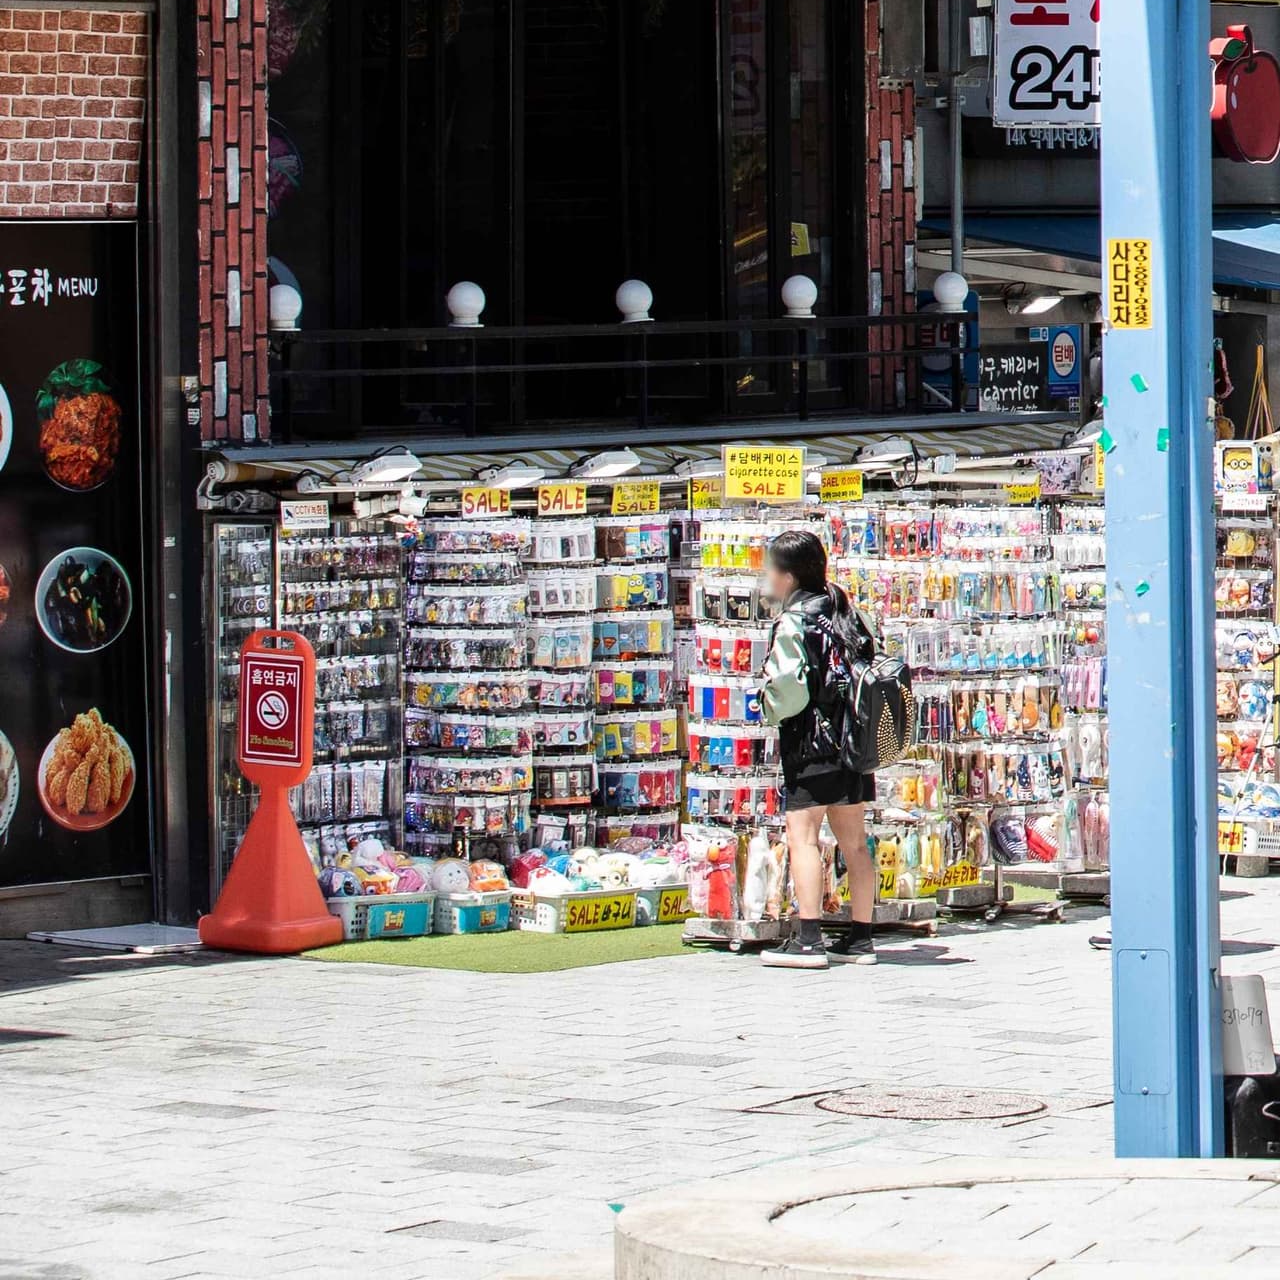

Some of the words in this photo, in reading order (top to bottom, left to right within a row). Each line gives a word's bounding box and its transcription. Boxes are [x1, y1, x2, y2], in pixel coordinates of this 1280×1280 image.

[1010, 45, 1100, 111] 24
[57, 277, 98, 298] MENU
[1112, 242, 1131, 325] 사다리차
[1053, 344, 1074, 363] 담배
[983, 380, 1040, 402] carrier
[729, 466, 774, 479] cigarette
[775, 469, 799, 478] case
[691, 481, 721, 493] SAL
[742, 481, 787, 496] SALE
[463, 489, 510, 515] SALE
[540, 486, 586, 512] SALE
[616, 500, 656, 512] SALE
[251, 668, 297, 688] 흡연금지
[569, 904, 600, 928] SALE
